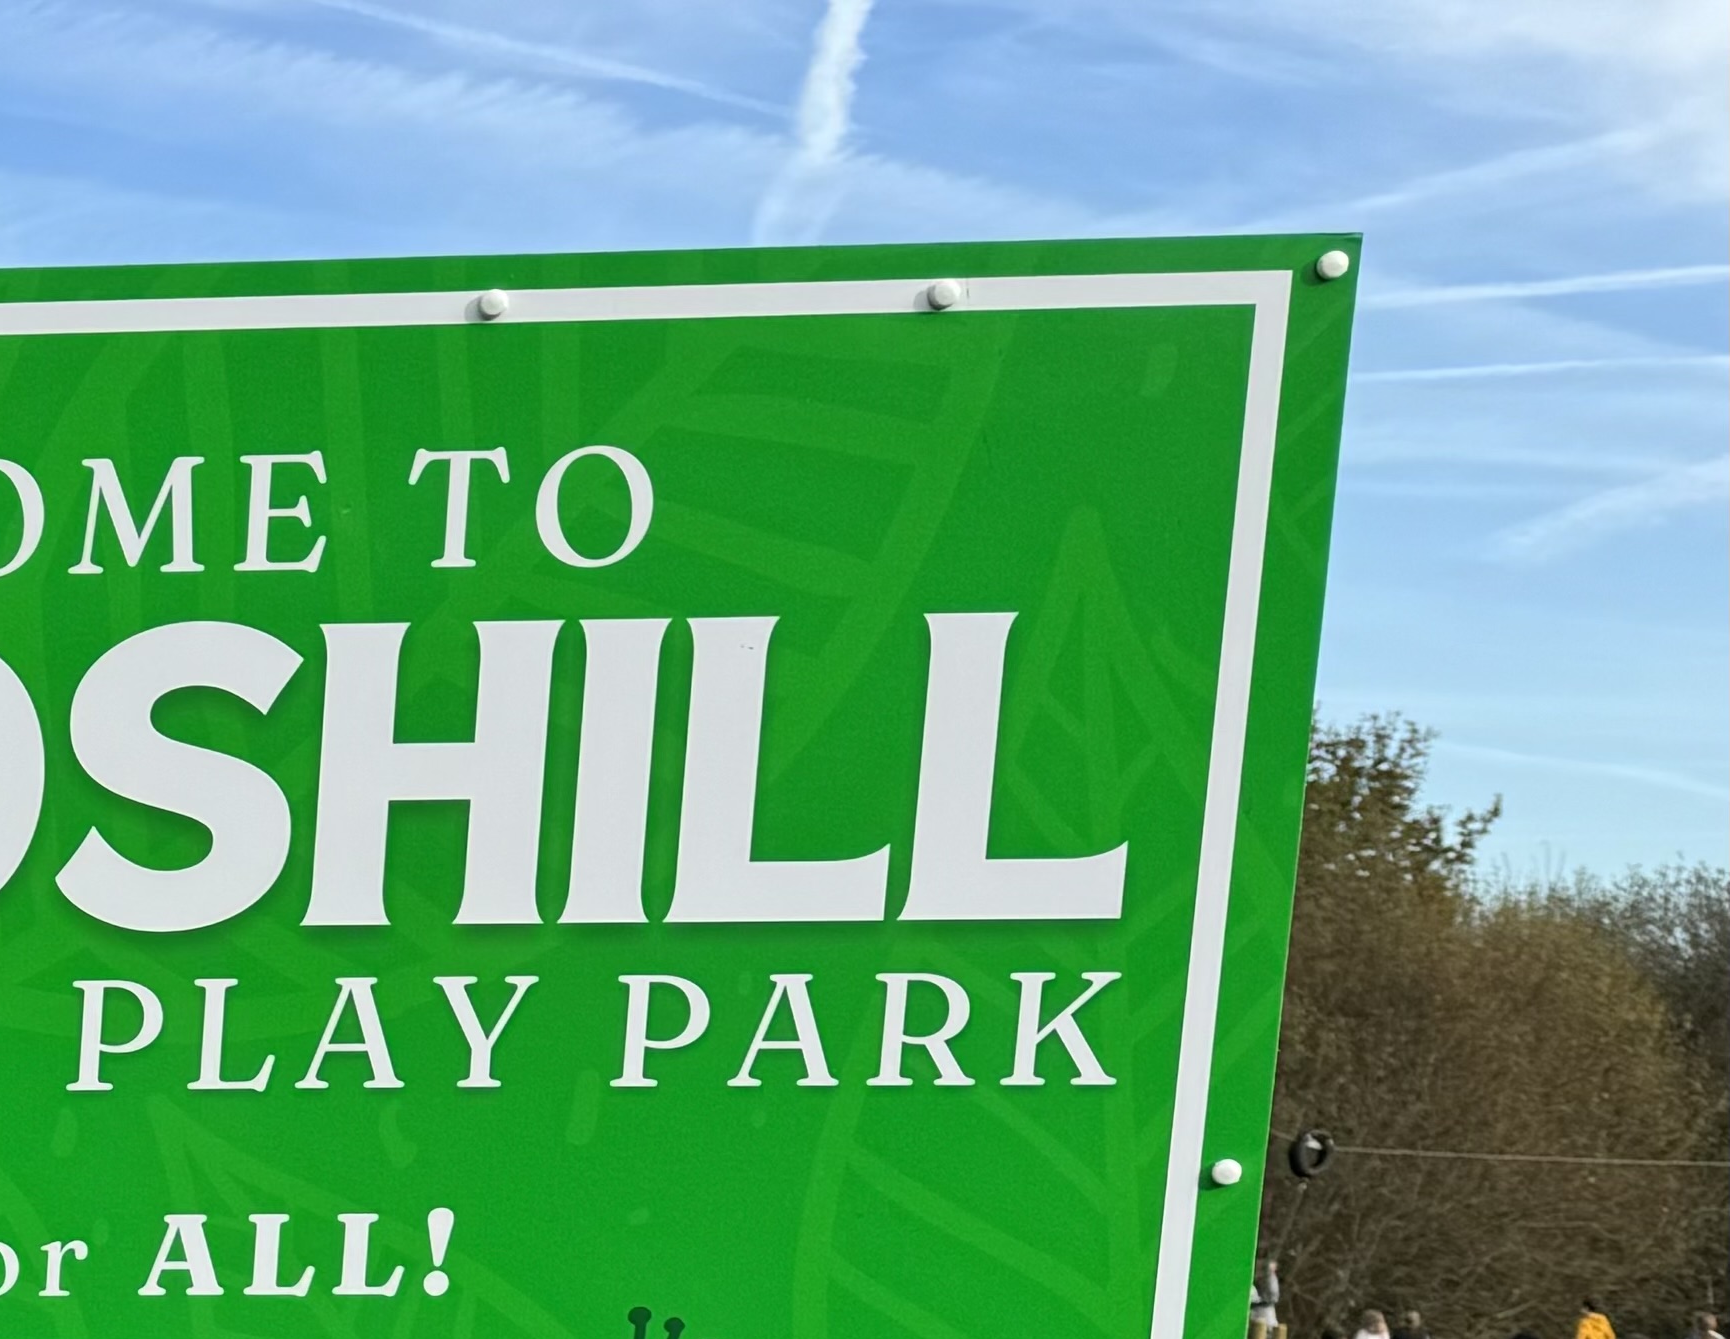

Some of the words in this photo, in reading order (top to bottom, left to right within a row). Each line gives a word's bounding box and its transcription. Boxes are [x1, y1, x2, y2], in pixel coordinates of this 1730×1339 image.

[407, 443, 655, 569] TO
[64, 974, 541, 1093] PLAY
[608, 970, 1123, 1089] PARK
[136, 1206, 456, 1299] ALL!
